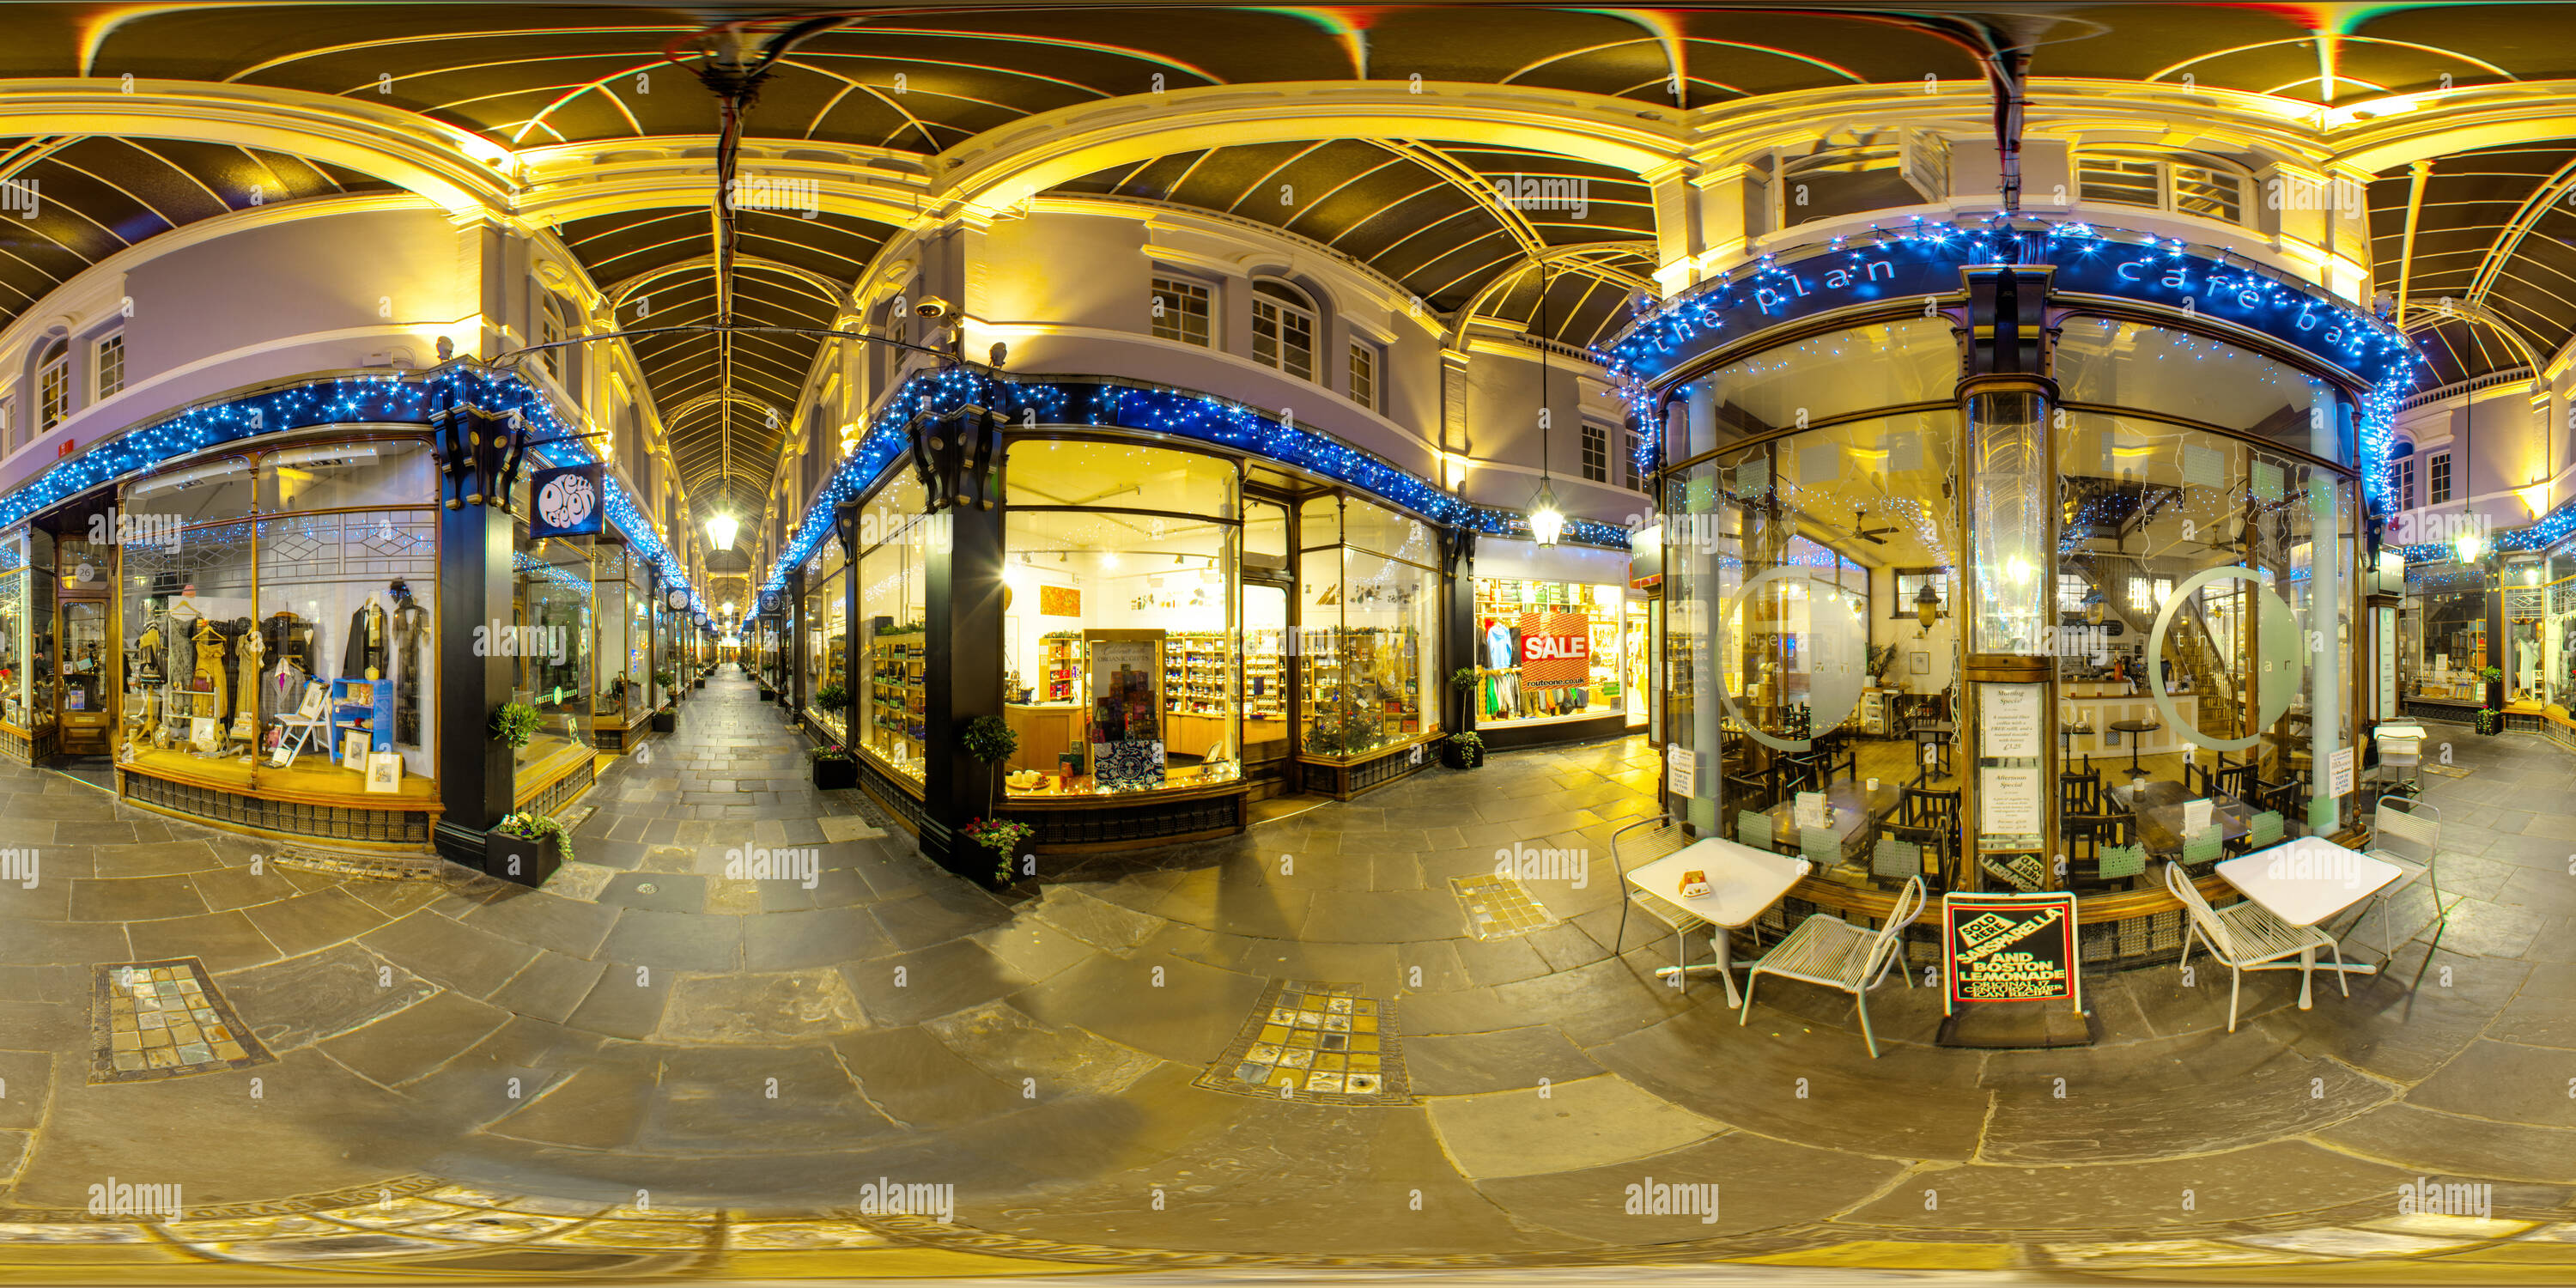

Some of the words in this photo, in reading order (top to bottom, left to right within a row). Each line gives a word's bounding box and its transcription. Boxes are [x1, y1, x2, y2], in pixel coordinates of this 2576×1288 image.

[2117, 261, 2260, 310] cafe
[1652, 310, 1721, 353] the
[1753, 259, 1895, 315] plan
[79, 568, 91, 577] 26
[1733, 632, 1778, 647] the
[2176, 631, 2230, 647] the
[1525, 636, 1586, 659] SALE
[1527, 677, 1585, 687] routeone.co.uk
[535, 694, 554, 705] PRETTY
[563, 689, 578, 699] GREEN
[1962, 915, 1996, 936] SOLD
[1971, 922, 2006, 942] HERE
[1956, 908, 2063, 964] SARSPARELLA
[1990, 952, 2033, 963] AND
[1972, 961, 2054, 973] BOSTON
[1959, 969, 2066, 982] LEMONADE
[2008, 989, 2054, 998] RECIPE
